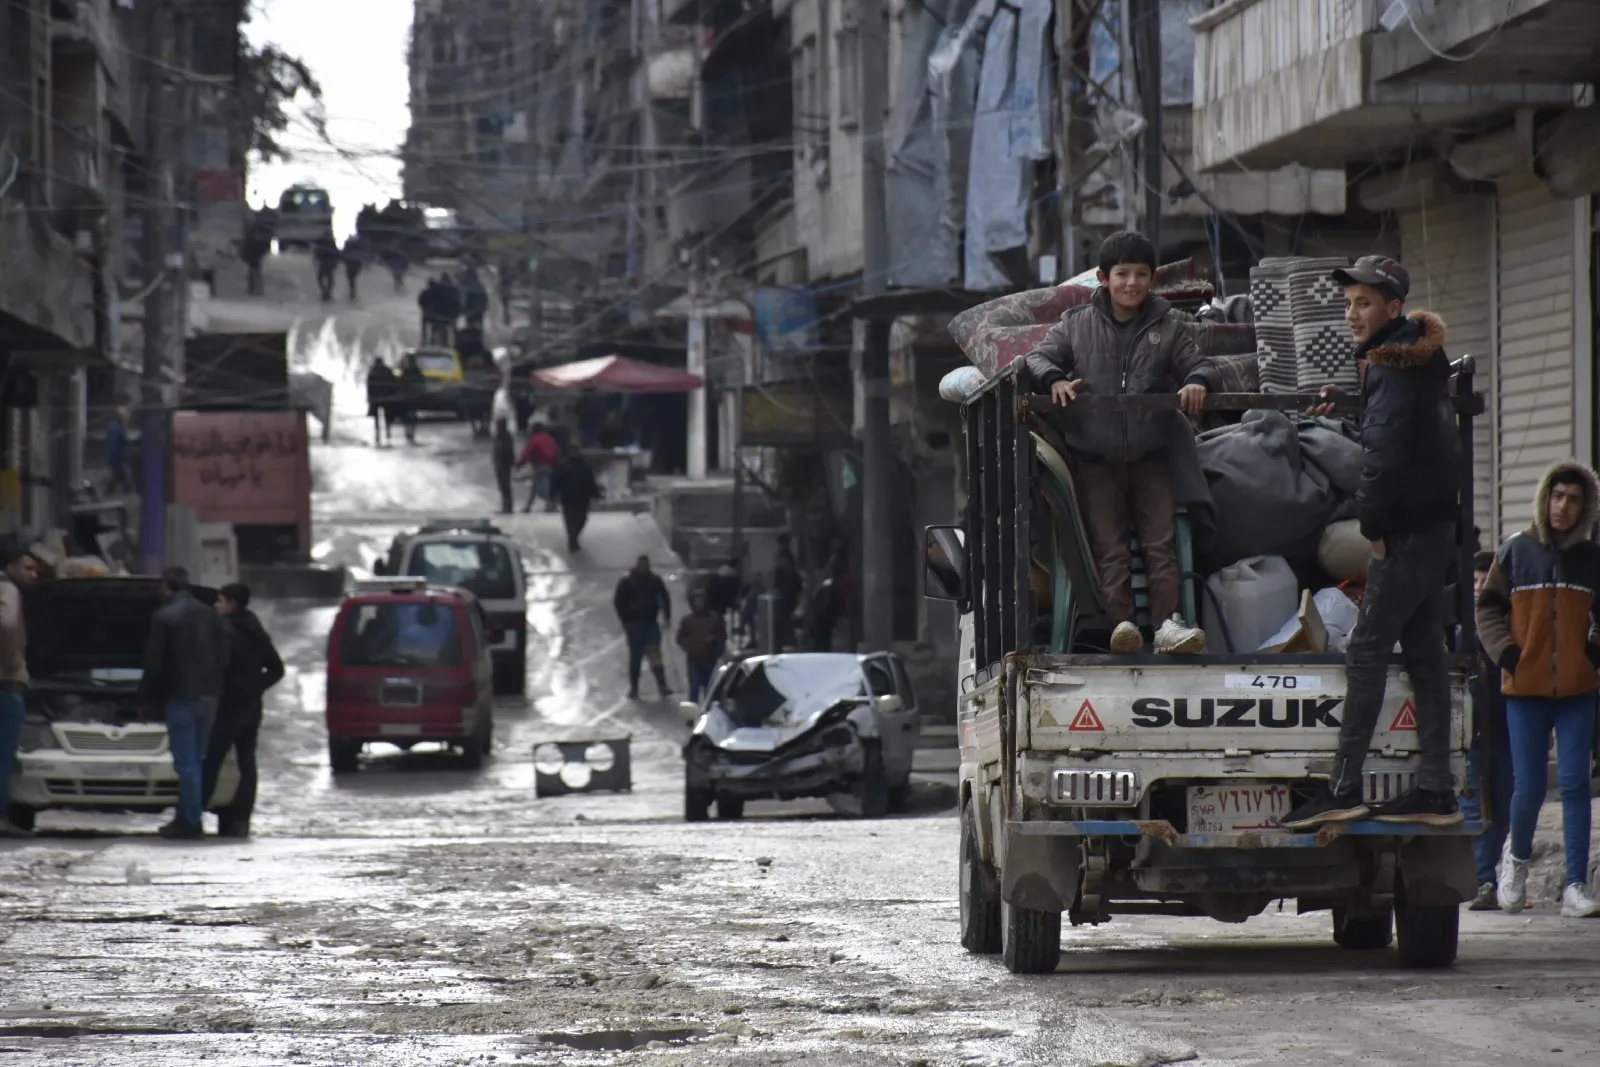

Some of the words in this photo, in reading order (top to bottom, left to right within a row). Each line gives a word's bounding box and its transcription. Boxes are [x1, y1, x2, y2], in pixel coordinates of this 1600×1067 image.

[1251, 675, 1297, 689] 470
[1131, 697, 1344, 728] SUZUK
[1191, 804, 1216, 816] SYR
